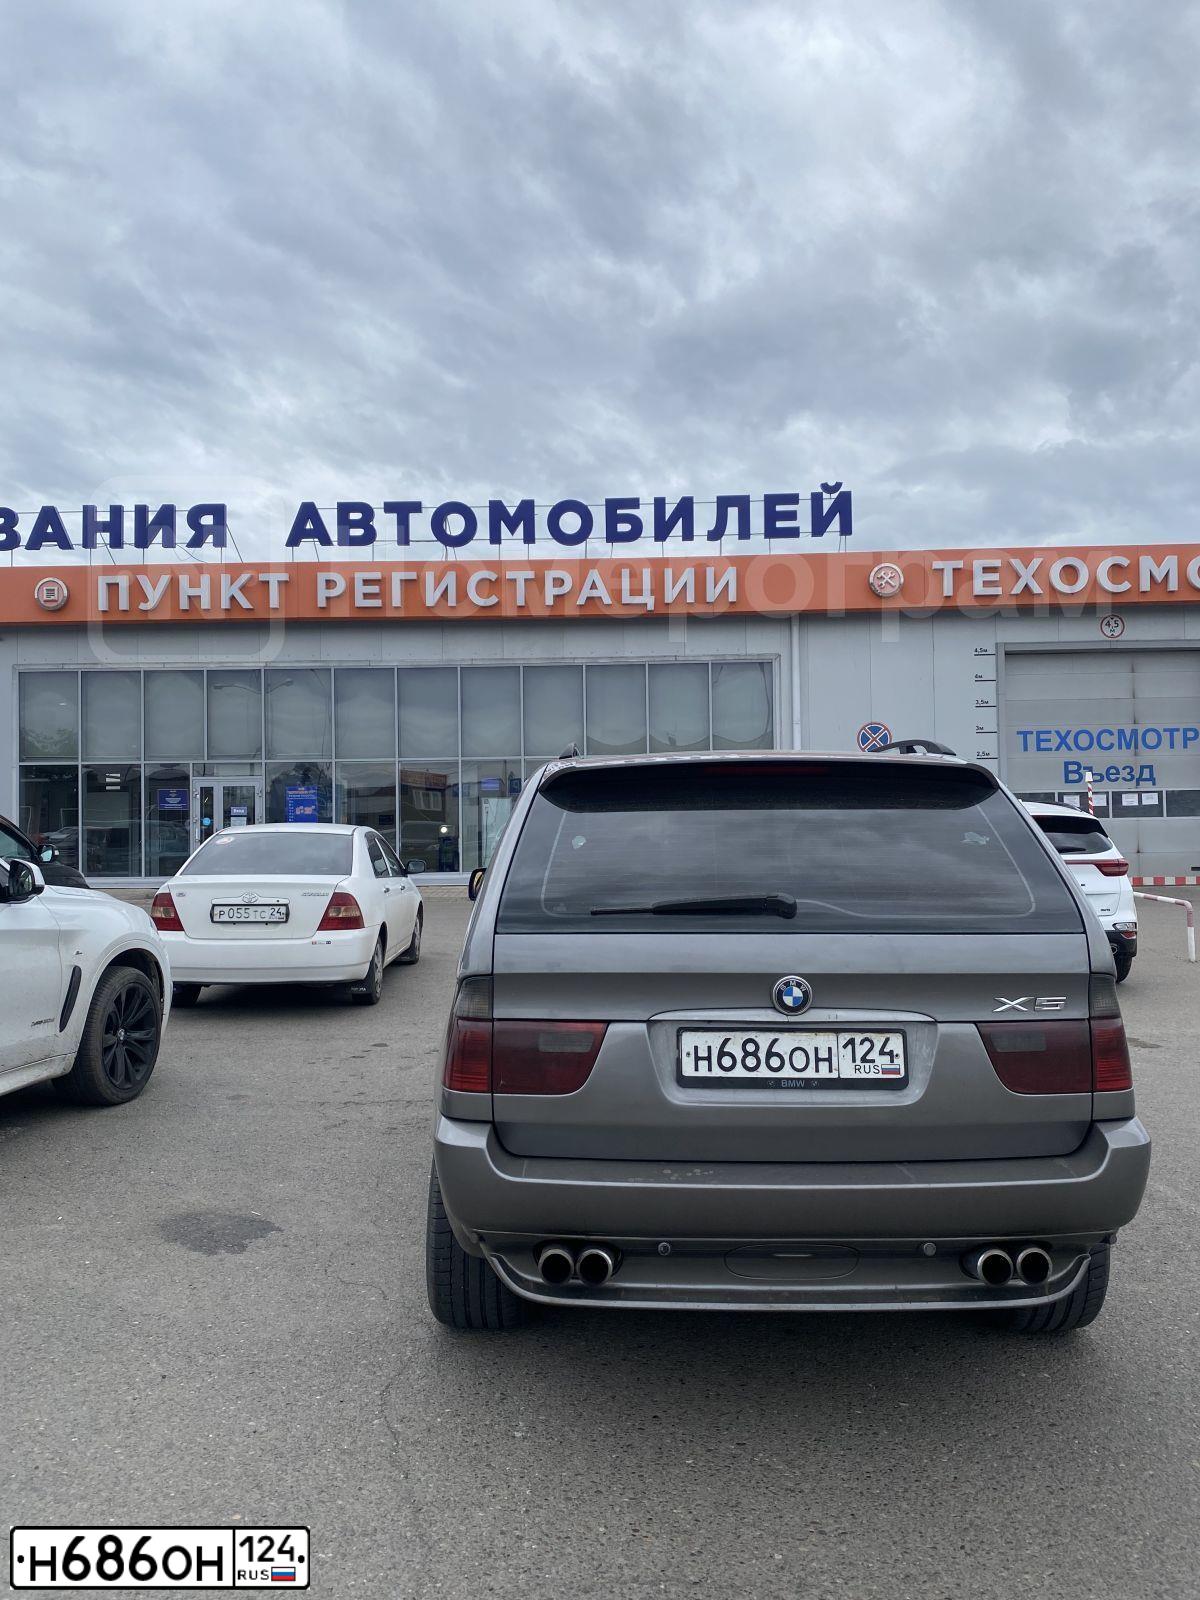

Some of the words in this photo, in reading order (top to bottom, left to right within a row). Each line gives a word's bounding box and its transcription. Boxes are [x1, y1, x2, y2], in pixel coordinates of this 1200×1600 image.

[285, 481, 853, 548] АВТОМОБИЛЕЙ
[97, 571, 290, 611] ПУНКТ
[316, 566, 738, 611] РЕГИСТРАЦИИ
[1016, 727, 1199, 752] ТЕХОСМОТР
[1063, 760, 1156, 786] Въезд
[270, 907, 282, 916] 24
[992, 995, 1067, 1012] X5
[693, 1037, 833, 1073] Н686ОН
[842, 1037, 896, 1064] 124
[854, 1064, 880, 1075] RUS
[781, 1079, 805, 1088] BMW
